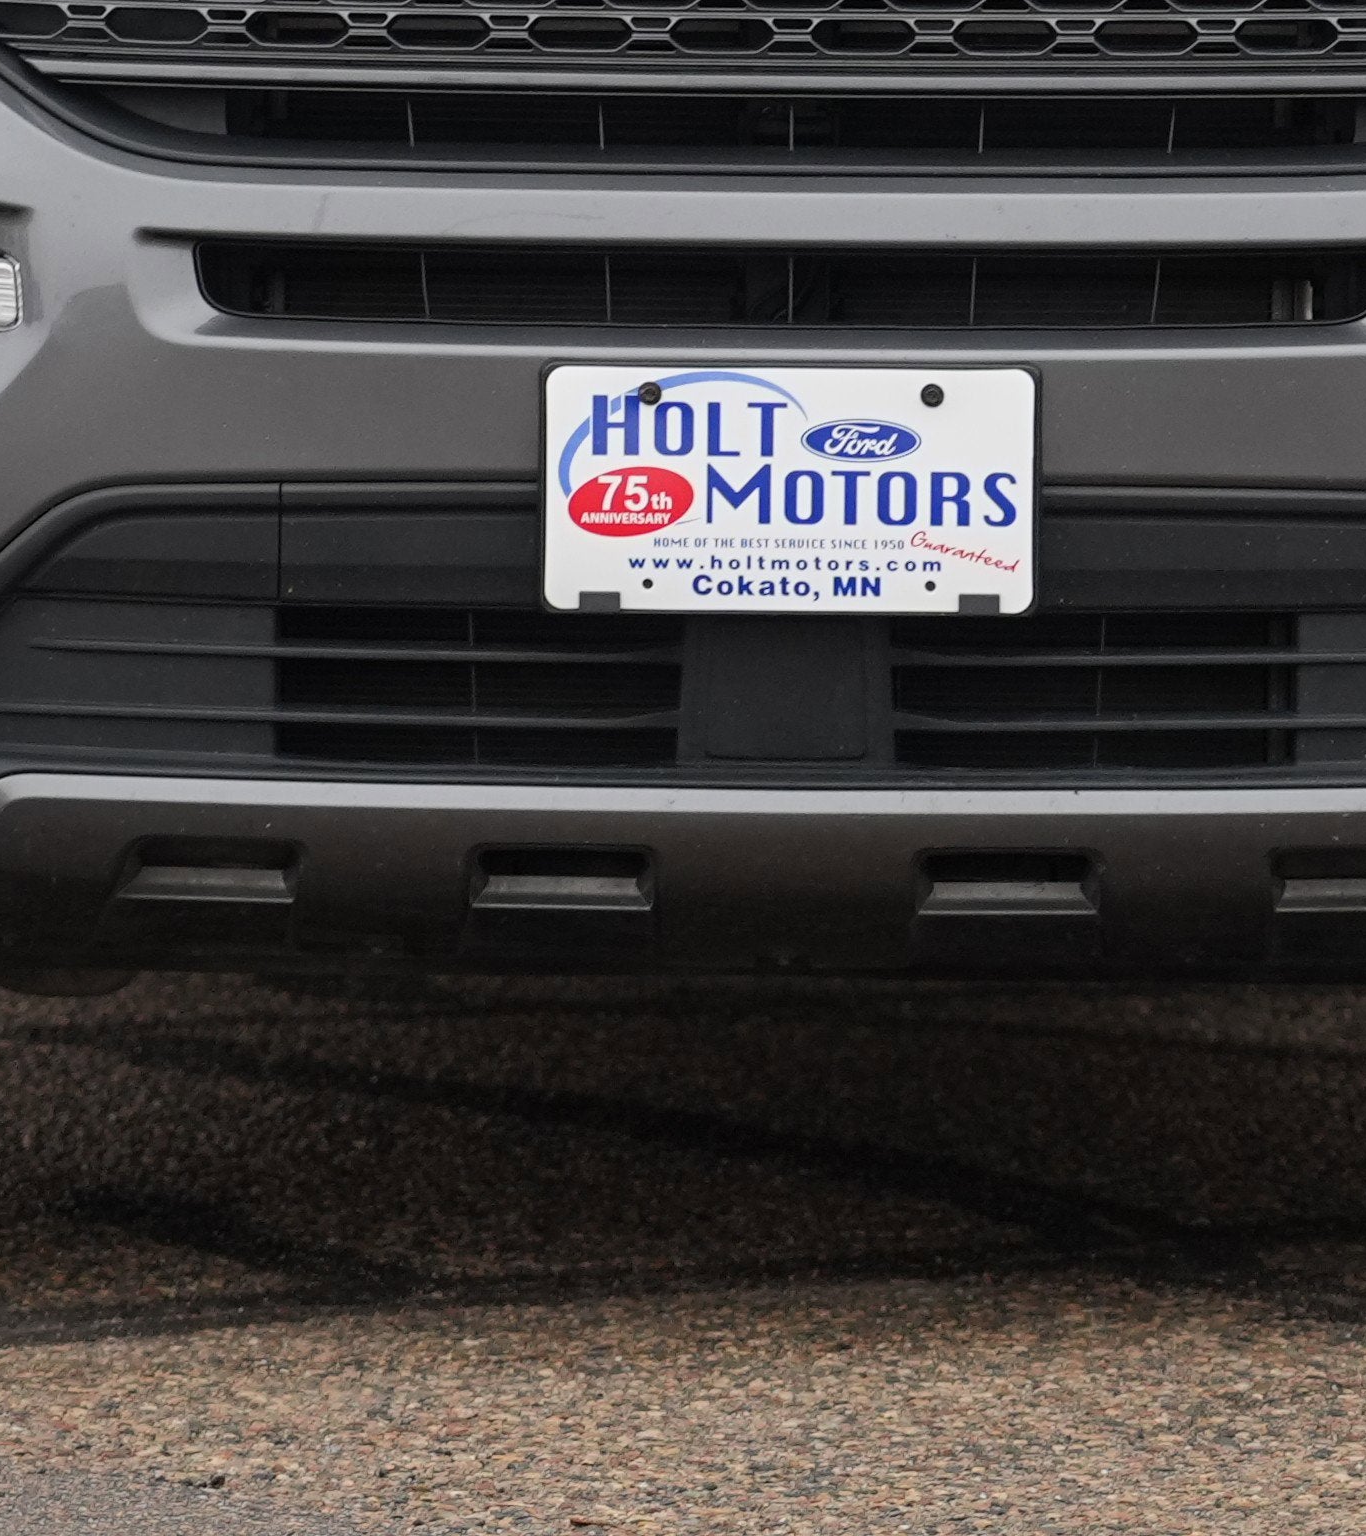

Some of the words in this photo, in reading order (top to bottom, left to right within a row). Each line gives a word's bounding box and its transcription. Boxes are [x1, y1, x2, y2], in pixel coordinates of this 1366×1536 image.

[591, 394, 788, 457] HOLT
[823, 423, 897, 459] Ford
[597, 474, 673, 512] 75th
[706, 463, 1018, 527] MOTORS
[580, 511, 672, 525] ANNIVERSARY
[653, 537, 690, 548] HOME
[694, 537, 709, 548] OF
[714, 537, 736, 549] THE
[740, 538, 770, 549] BEST
[774, 538, 826, 549] SERVICE
[830, 539, 867, 550] SINCE
[873, 539, 905, 551] 1950
[910, 530, 1021, 574] Guaranteed
[628, 554, 942, 572] www.holtmotors.com
[691, 574, 821, 601] Cokato,
[832, 576, 882, 597] MN
